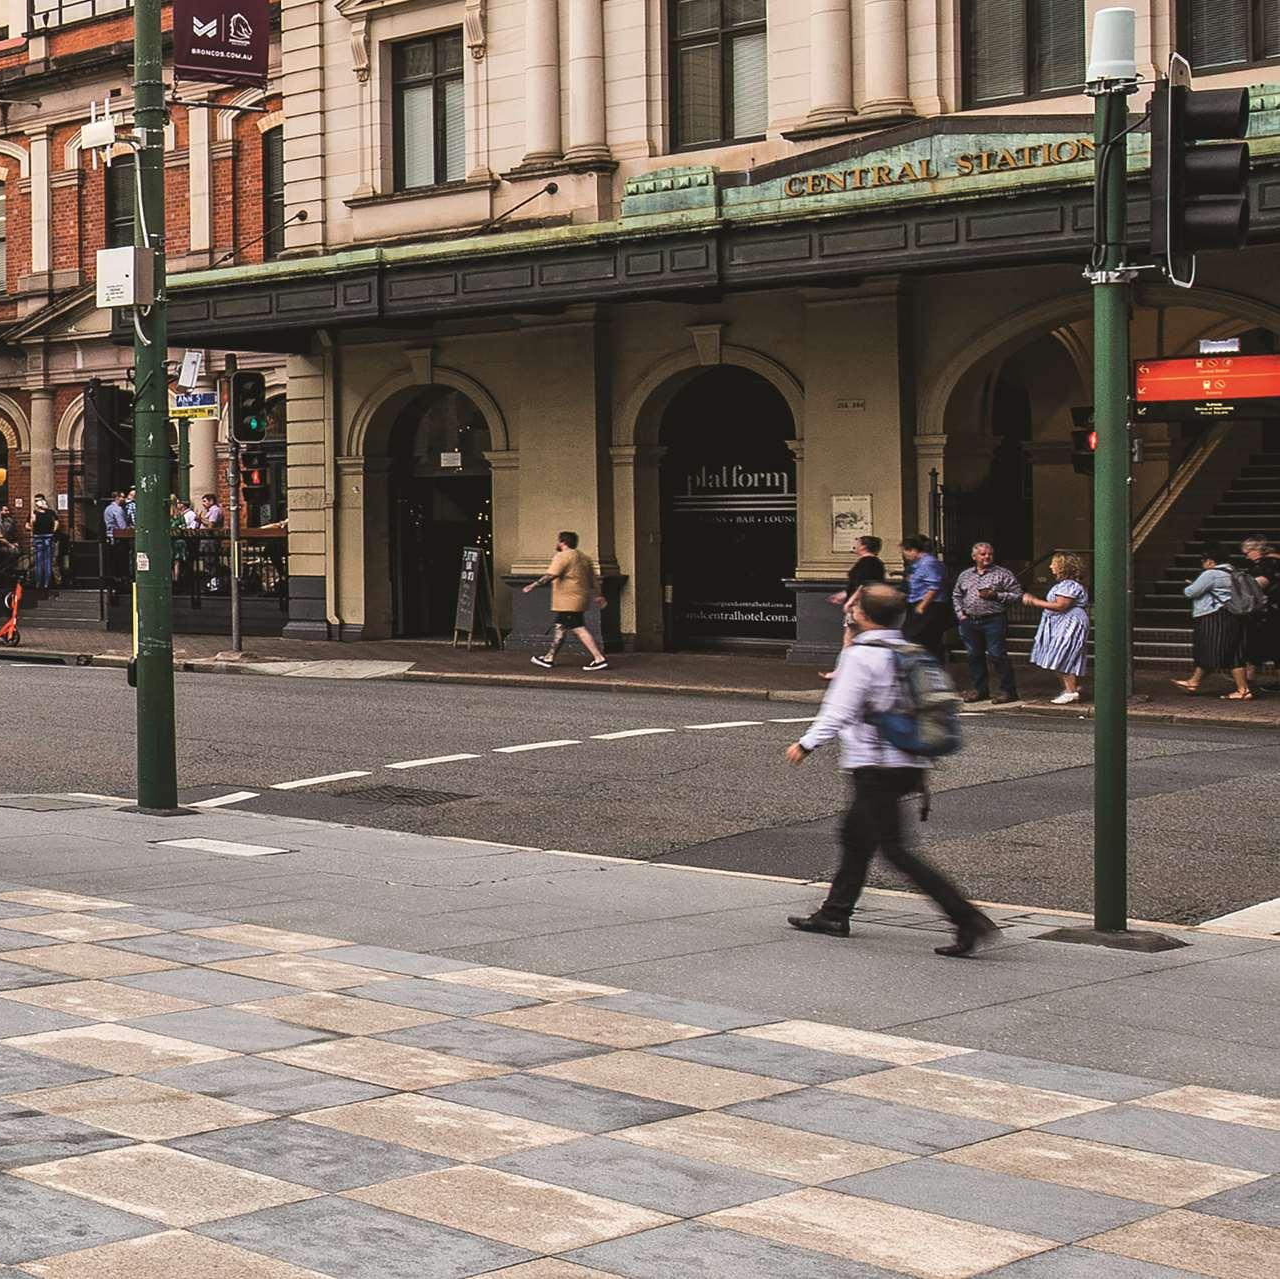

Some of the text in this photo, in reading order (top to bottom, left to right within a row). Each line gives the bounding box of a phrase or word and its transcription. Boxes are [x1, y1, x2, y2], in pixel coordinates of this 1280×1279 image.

[191, 48, 253, 60] BRONCOS.COM.AU
[784, 137, 1097, 197] CENTRAL STATION
[687, 465, 788, 496] platform
[764, 515, 795, 523] LOUN
